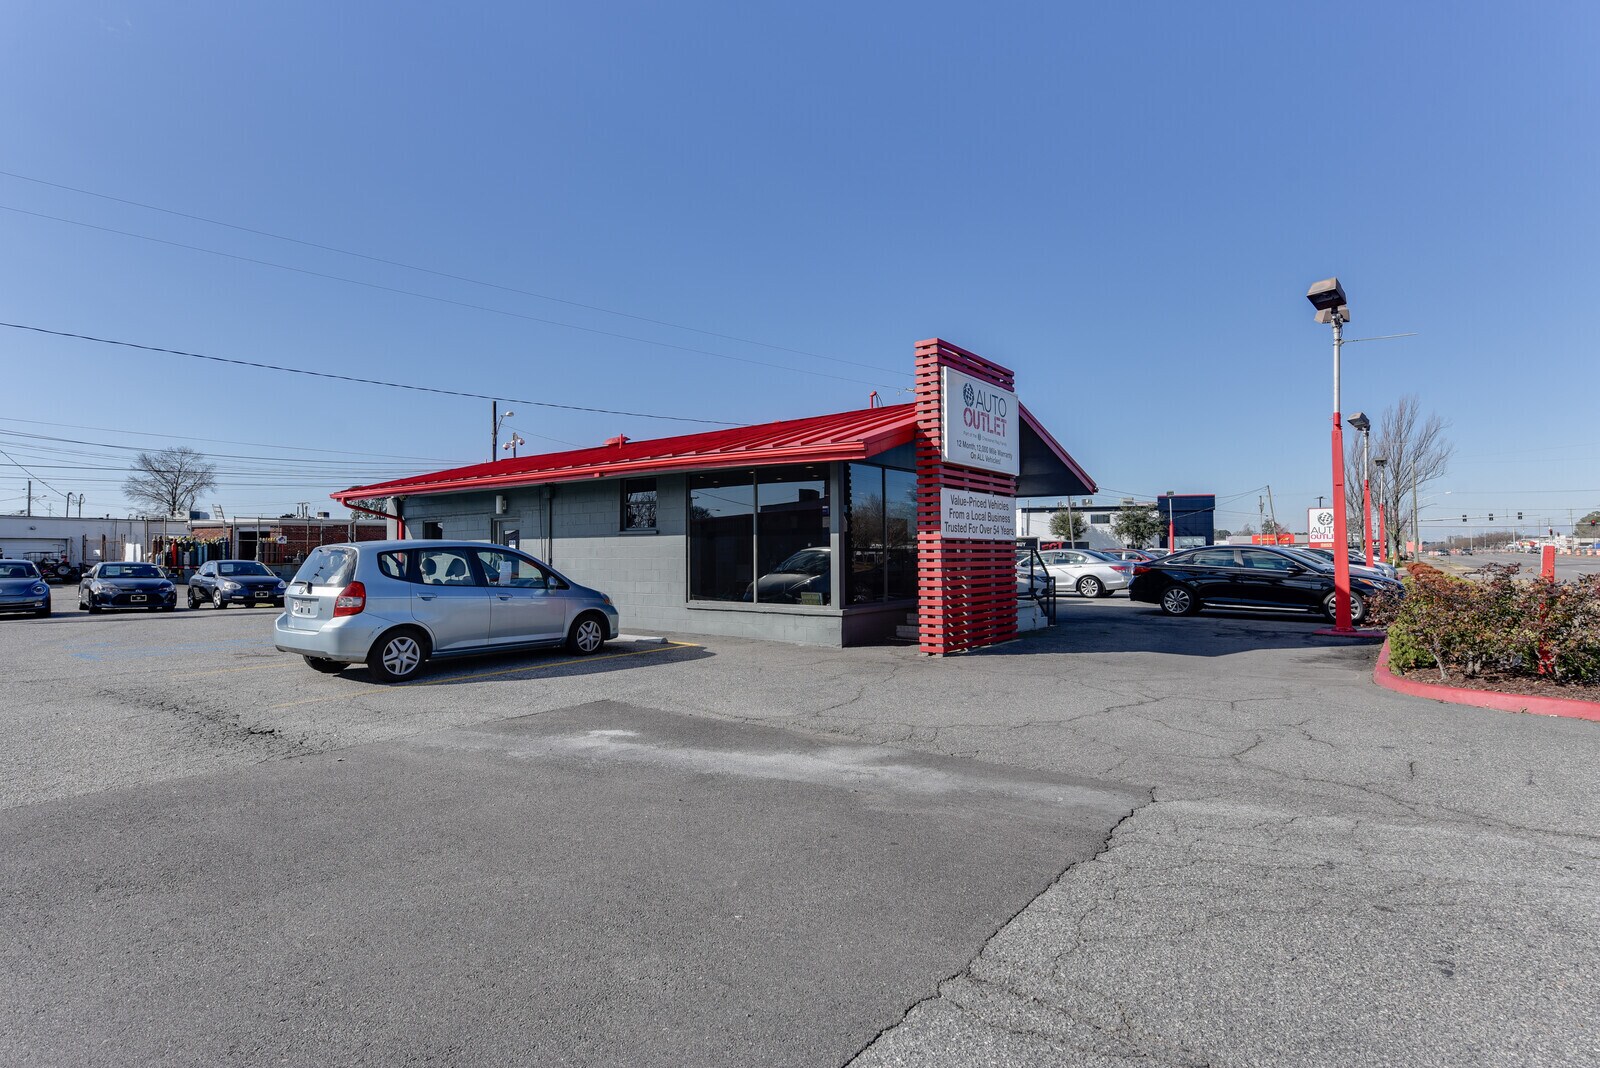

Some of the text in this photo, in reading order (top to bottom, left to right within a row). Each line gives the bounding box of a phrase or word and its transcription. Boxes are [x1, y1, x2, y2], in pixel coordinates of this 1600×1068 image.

[976, 390, 1007, 417] AUTO
[963, 407, 1007, 437] OUTLET
[989, 447, 997, 455] Mile
[997, 449, 1012, 460] Warranty
[951, 495, 1009, 511] Value-Priced Vehicles
[949, 508, 1010, 523] From a Local Business
[945, 522, 1014, 535] Trusted For Over 54 Years
